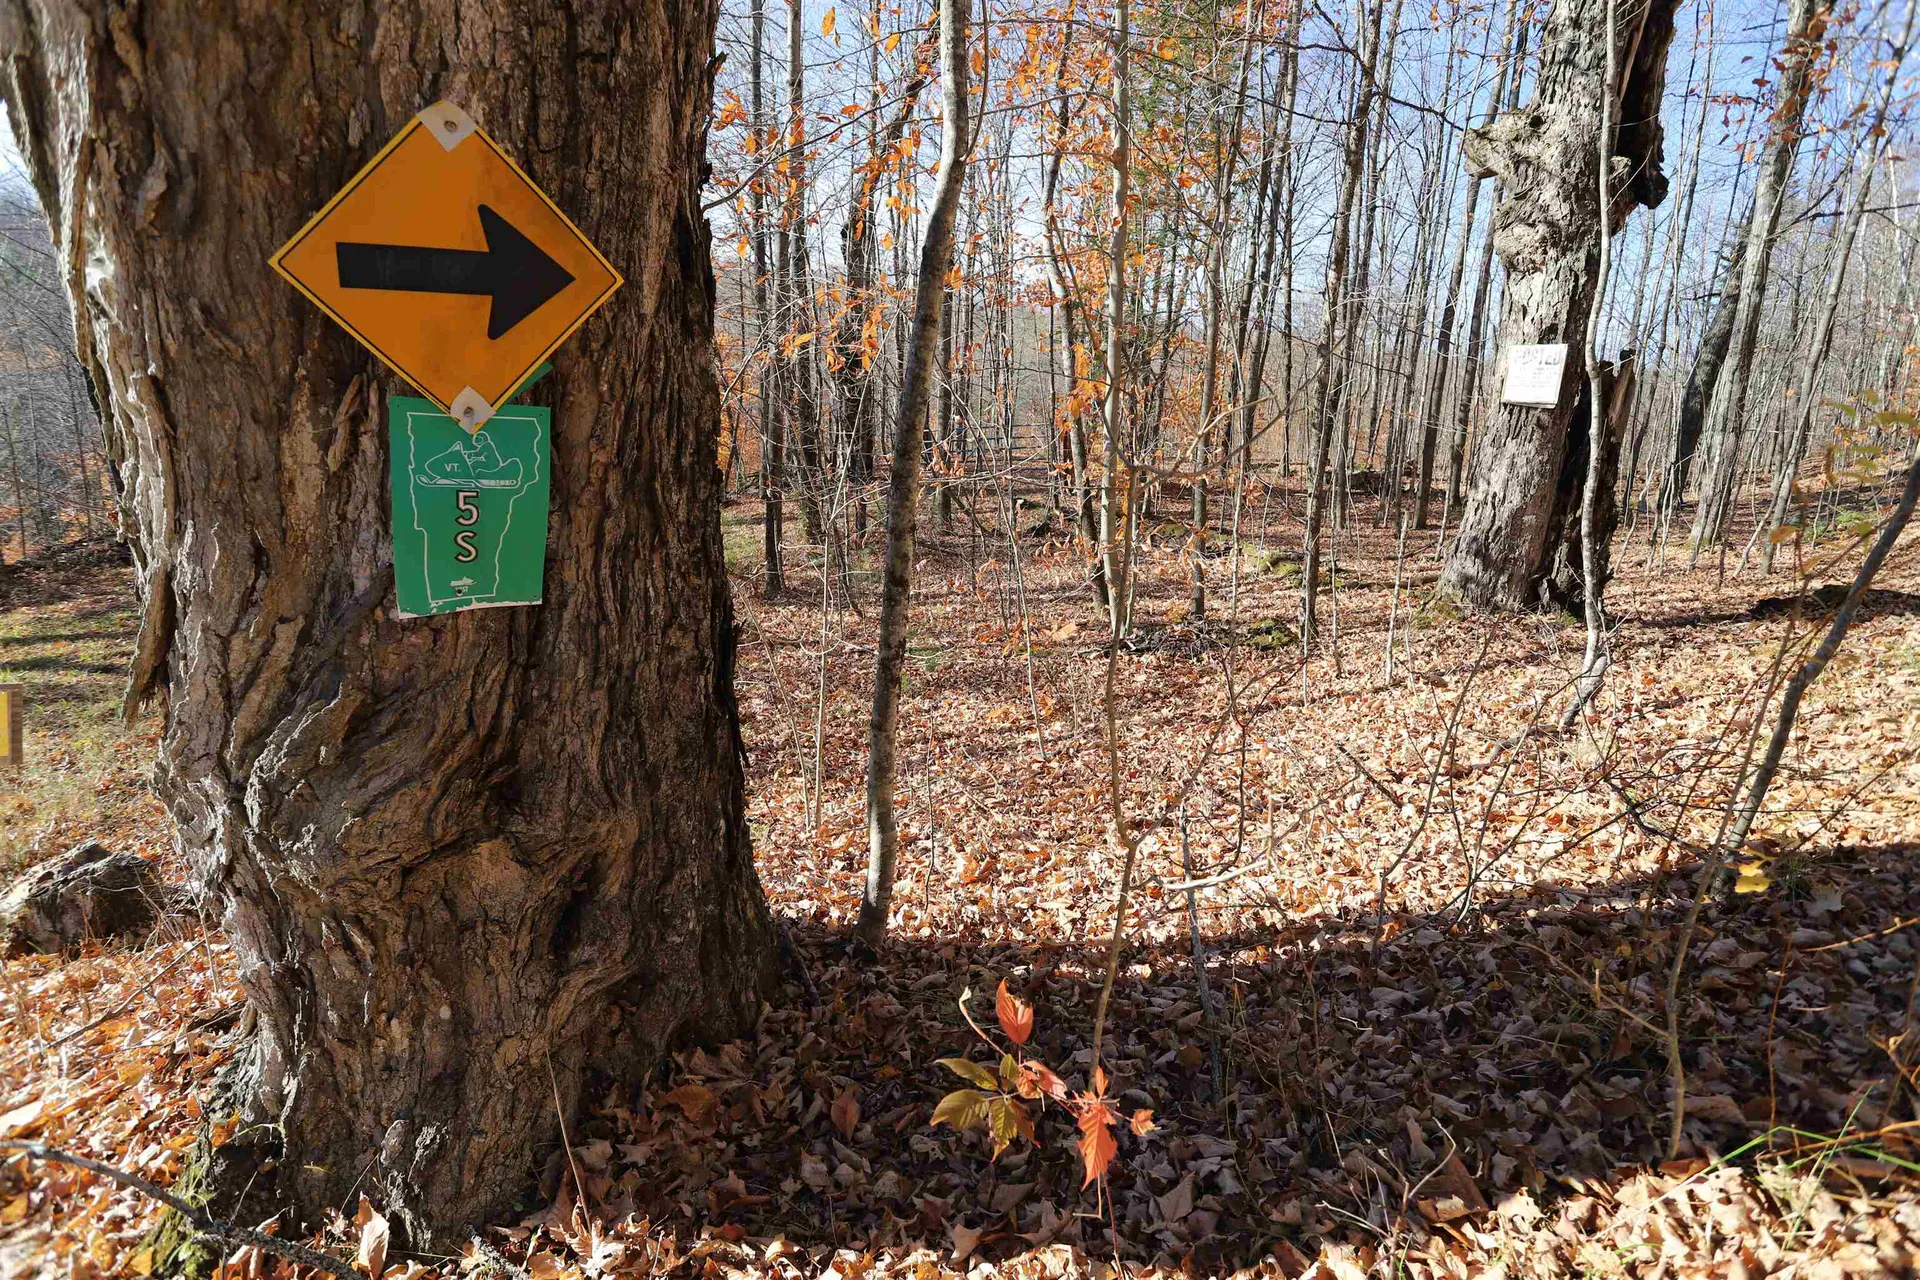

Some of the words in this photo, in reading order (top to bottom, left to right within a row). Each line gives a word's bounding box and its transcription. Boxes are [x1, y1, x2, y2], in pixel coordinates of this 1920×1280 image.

[444, 463, 461, 472] VT.
[455, 490, 480, 527] 5
[454, 530, 478, 563] S
